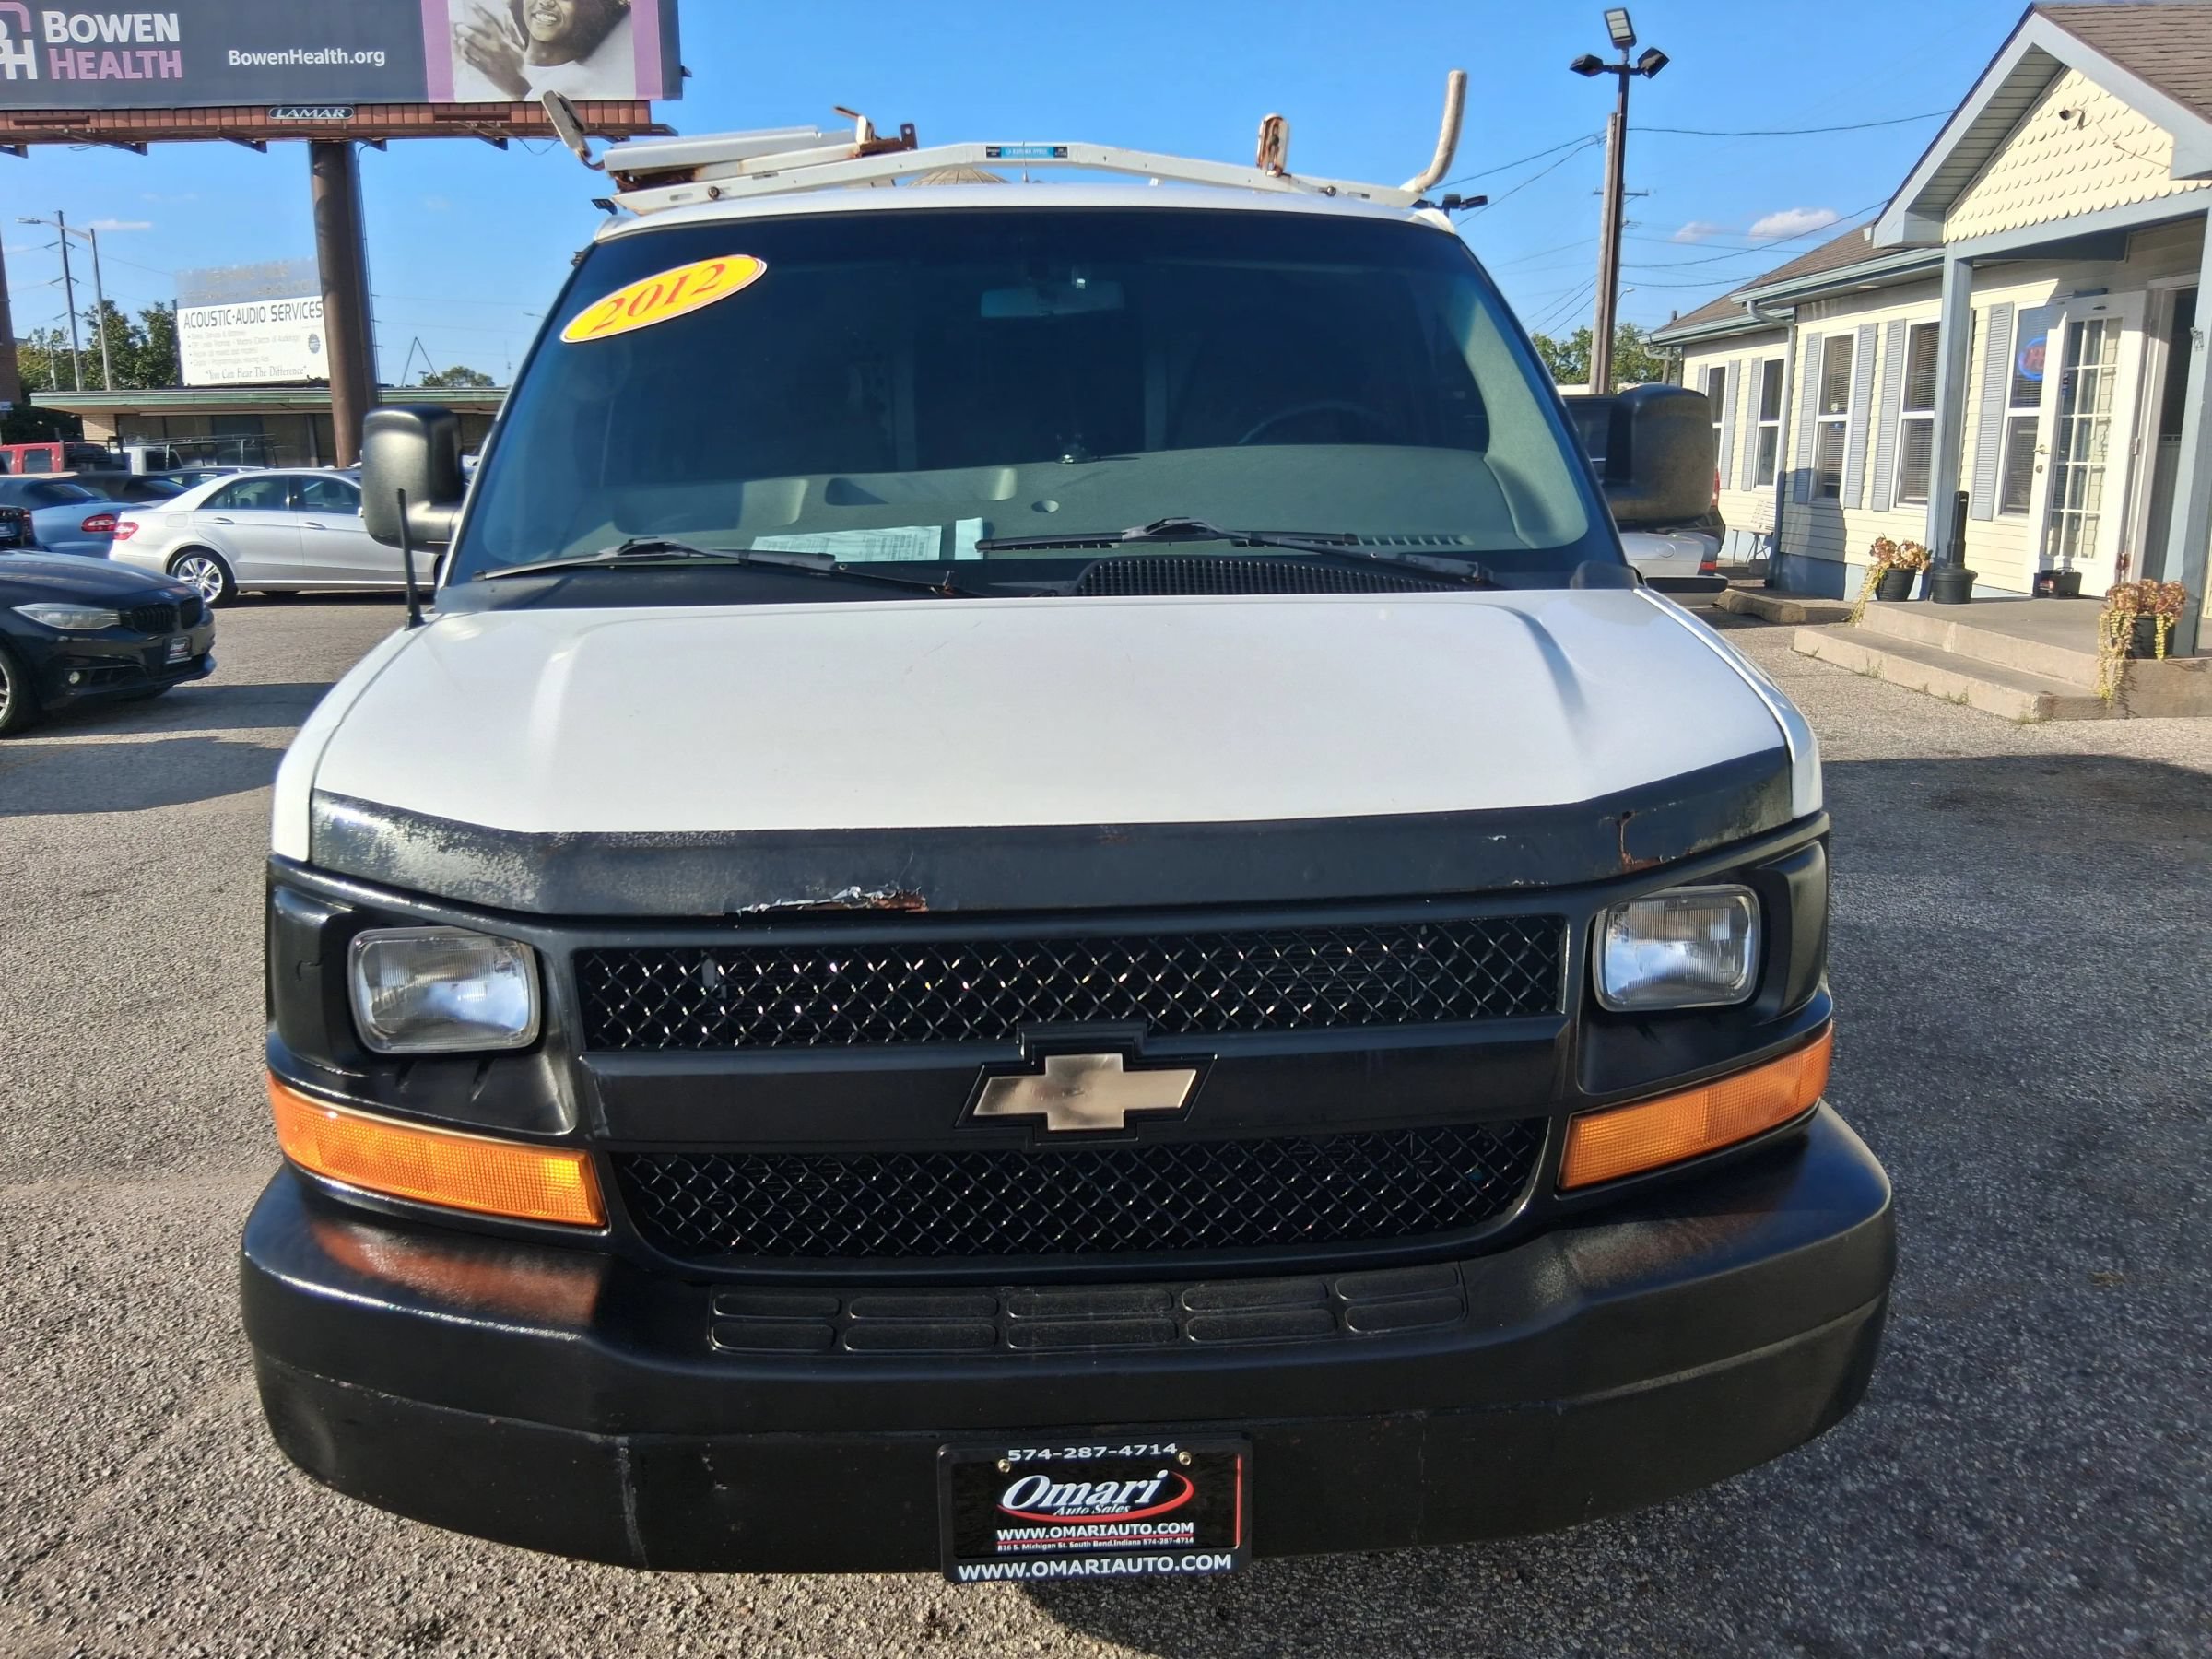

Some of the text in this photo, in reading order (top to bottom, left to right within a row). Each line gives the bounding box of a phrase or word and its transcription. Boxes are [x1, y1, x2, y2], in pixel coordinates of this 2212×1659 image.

[41, 10, 180, 43] BOWEN
[48, 48, 183, 80] HEALTH
[228, 48, 385, 66] BowenHealth.org
[276, 108, 346, 118] LAMAR
[588, 264, 726, 335] 2012
[270, 300, 323, 322] SERVICES
[237, 367, 253, 378] Hear
[254, 366, 266, 377] The
[1007, 1443, 1178, 1461] 574-287-4714
[1003, 1469, 1169, 1510] Omari
[1053, 1503, 1132, 1516] Auto Sales
[996, 1522, 1194, 1541] WWW.OMARIAUTO.COM
[1021, 1542, 1056, 1550] Michigan
[1057, 1541, 1067, 1549] St.
[1069, 1540, 1091, 1548] South
[1143, 1536, 1194, 1546] 574-287-4714
[958, 1554, 1232, 1581] WWW.OMARIAUTO.COM
